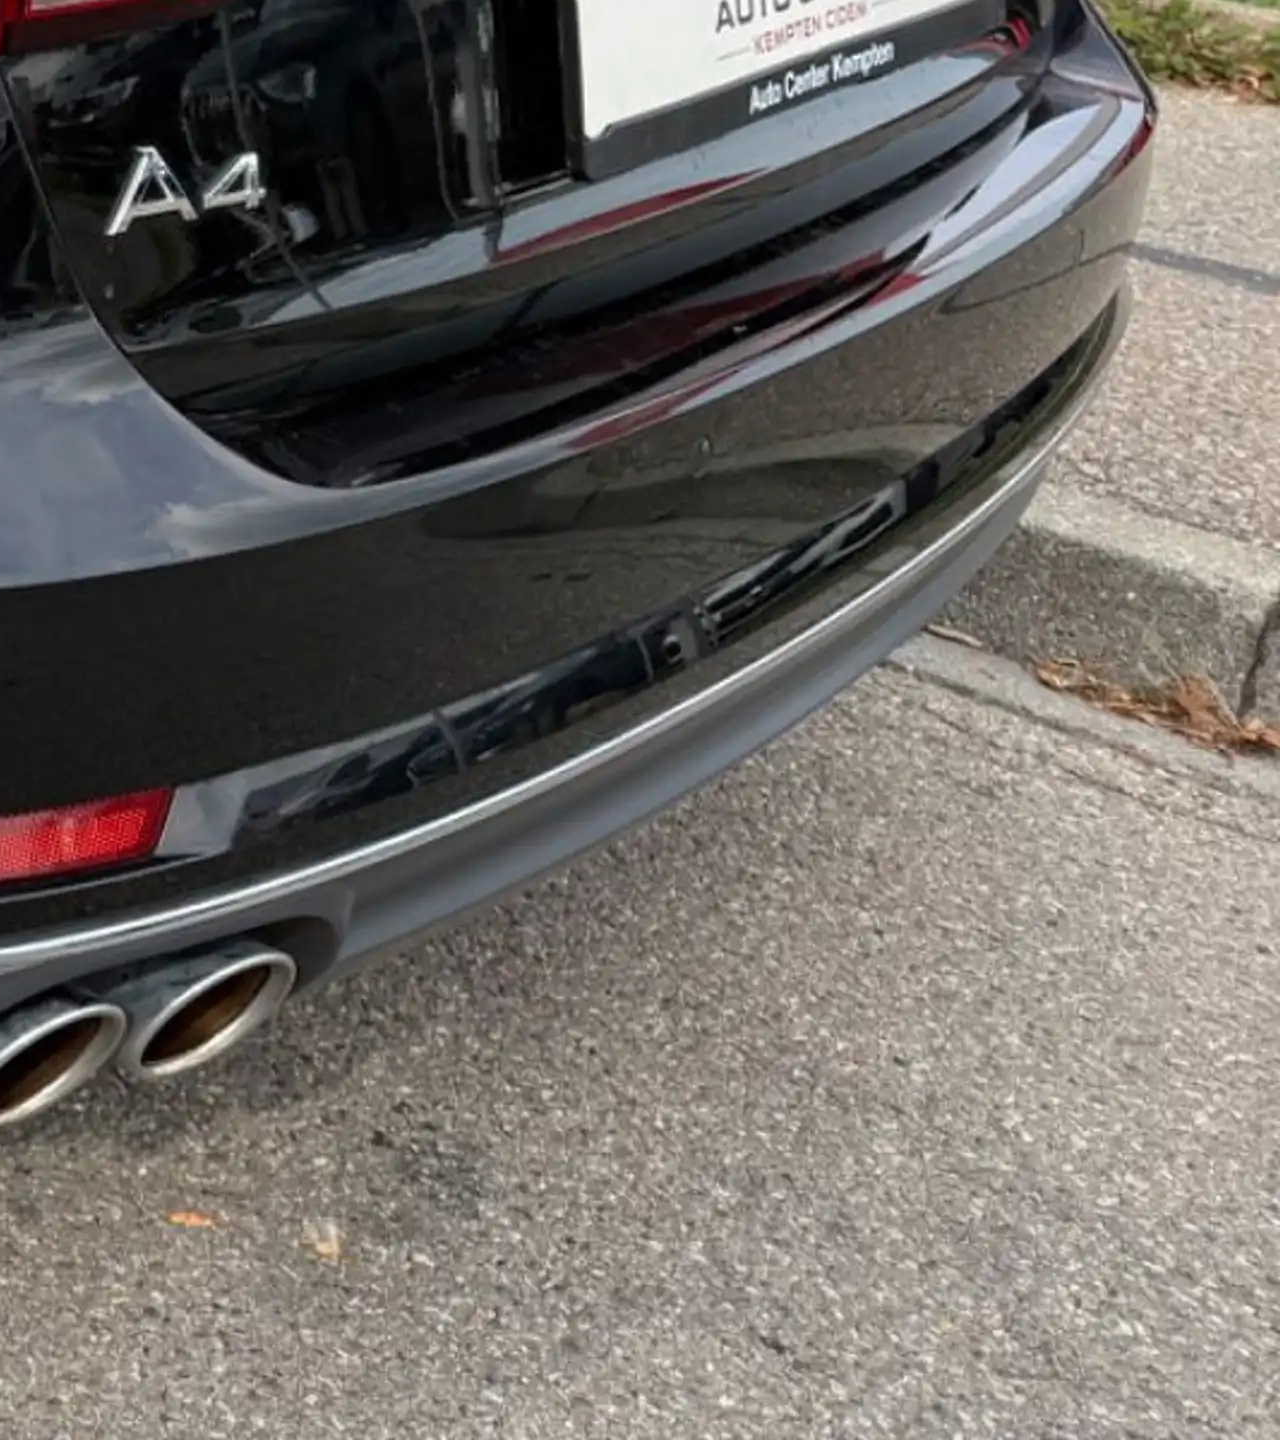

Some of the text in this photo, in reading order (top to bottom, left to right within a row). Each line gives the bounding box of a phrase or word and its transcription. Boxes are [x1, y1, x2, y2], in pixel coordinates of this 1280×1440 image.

[753, 15, 822, 55] KEMPTEN
[749, 40, 895, 114] Auto Center Kempten
[105, 145, 267, 237] A4
